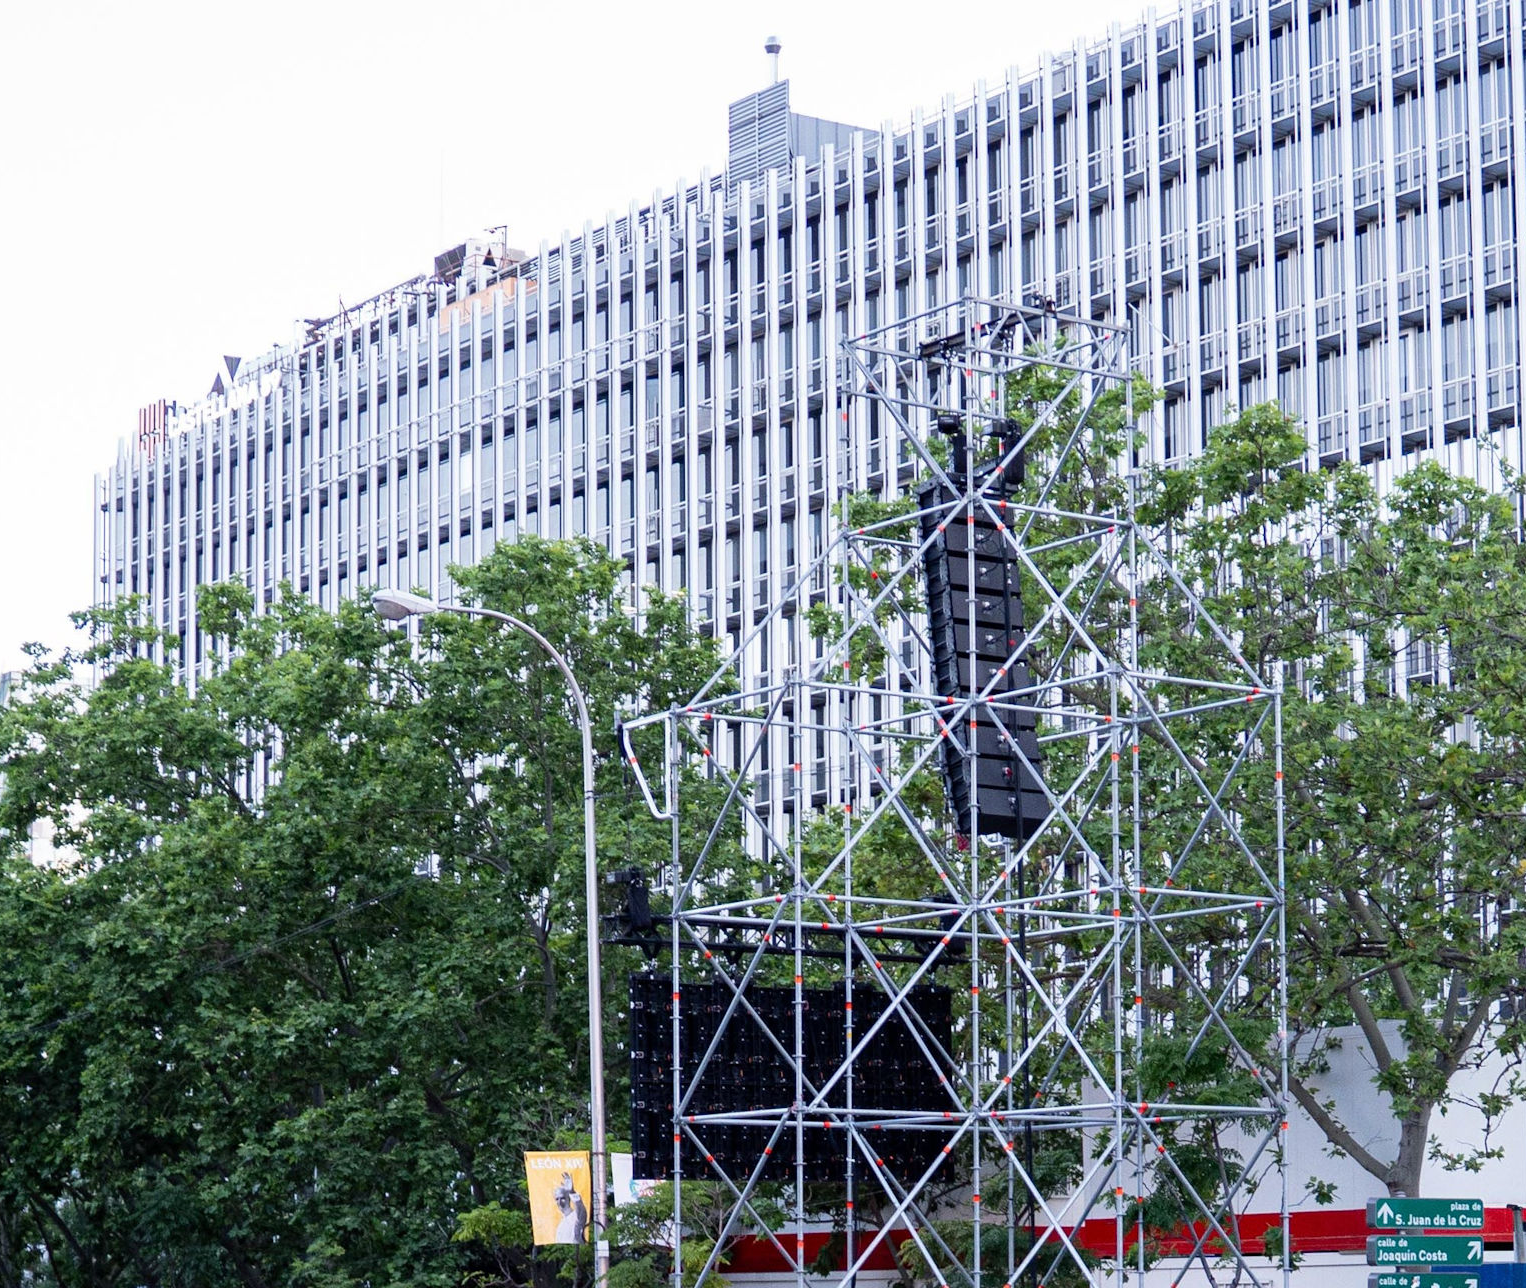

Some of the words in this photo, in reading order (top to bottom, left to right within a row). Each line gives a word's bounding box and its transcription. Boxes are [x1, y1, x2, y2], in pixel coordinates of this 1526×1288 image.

[530, 1157, 561, 1169] LEÓN
[564, 1158, 584, 1169] XIV
[1450, 1202, 1469, 1212] plaza
[1472, 1202, 1481, 1211] de
[1395, 1214, 1405, 1225] S.
[1407, 1214, 1431, 1225] Juan
[1433, 1214, 1445, 1225] de
[1448, 1214, 1457, 1225] la
[1459, 1214, 1482, 1226] Cruz
[1378, 1238, 1396, 1247] calle
[1398, 1238, 1408, 1247] de
[1419, 1250, 1447, 1261] Costa
[1379, 1277, 1396, 1285] calle
[1399, 1277, 1408, 1285] de
